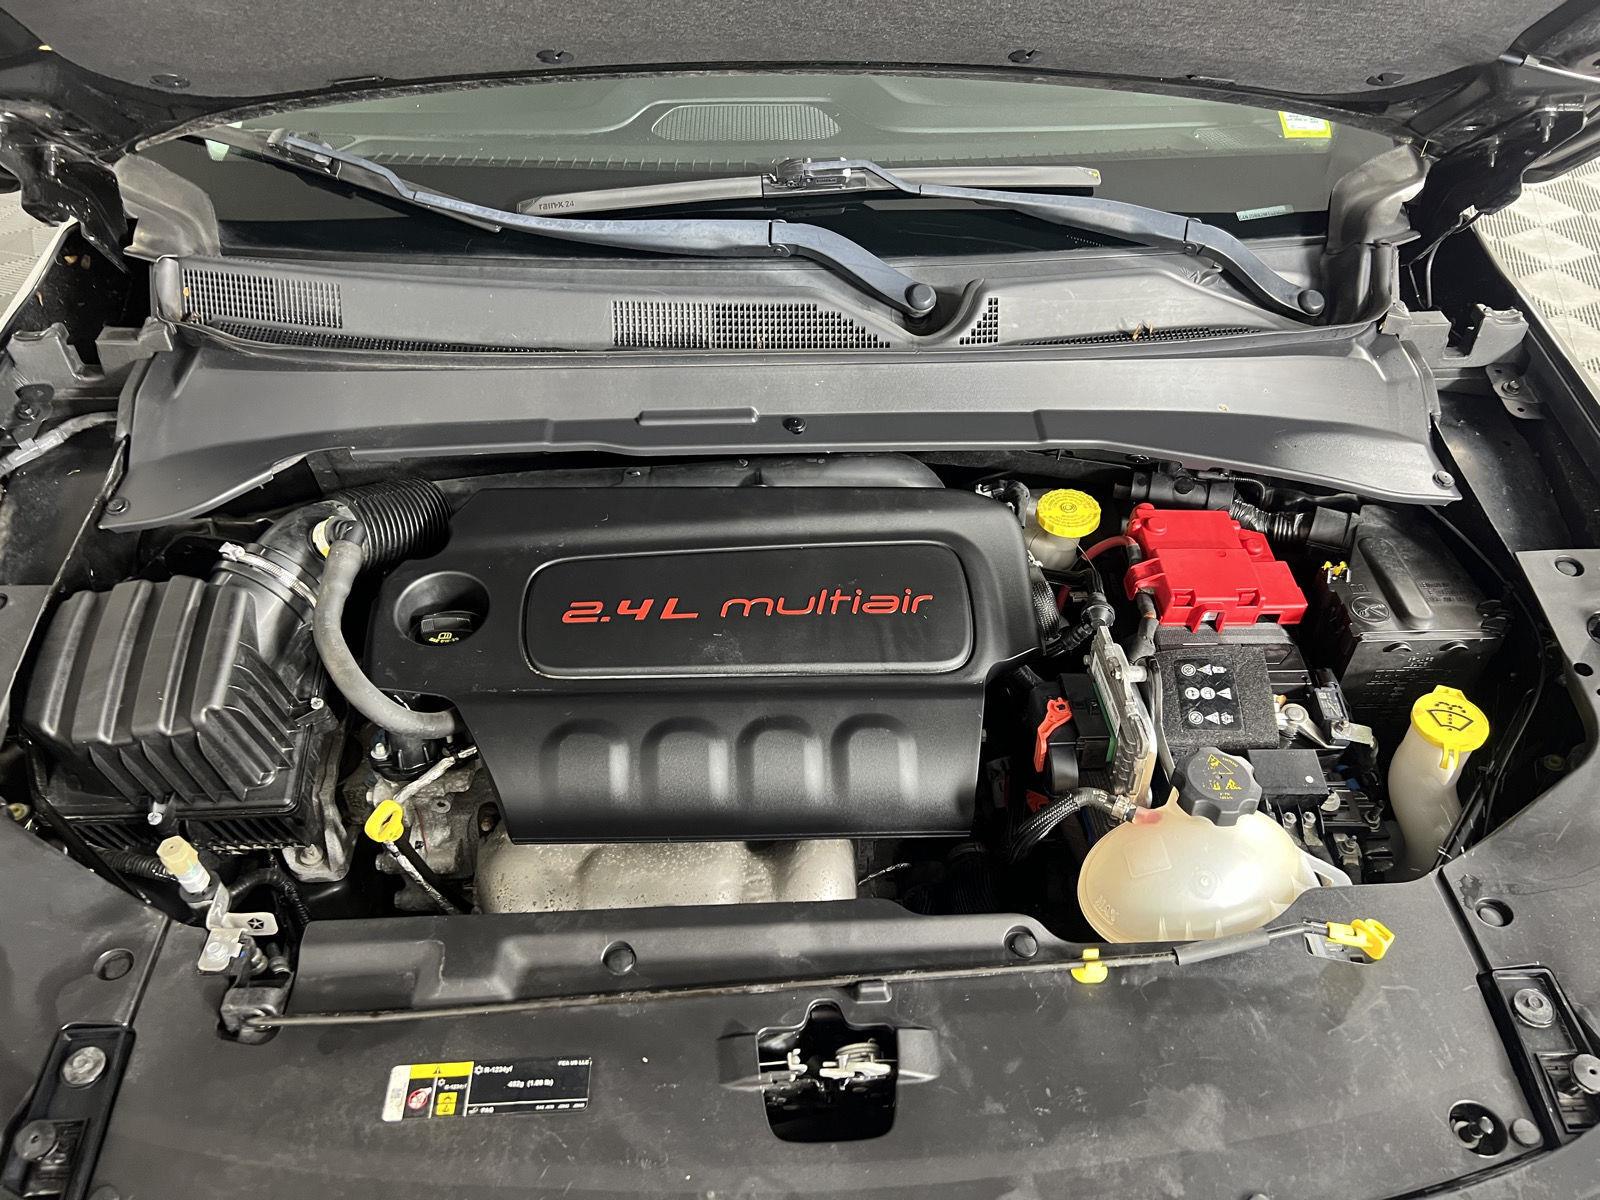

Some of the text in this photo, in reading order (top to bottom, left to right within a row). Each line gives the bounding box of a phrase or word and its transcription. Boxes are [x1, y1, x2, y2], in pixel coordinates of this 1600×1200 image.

[565, 200, 575, 208] 24
[719, 588, 933, 617] multiair
[483, 1064, 514, 1074] R-1234yf
